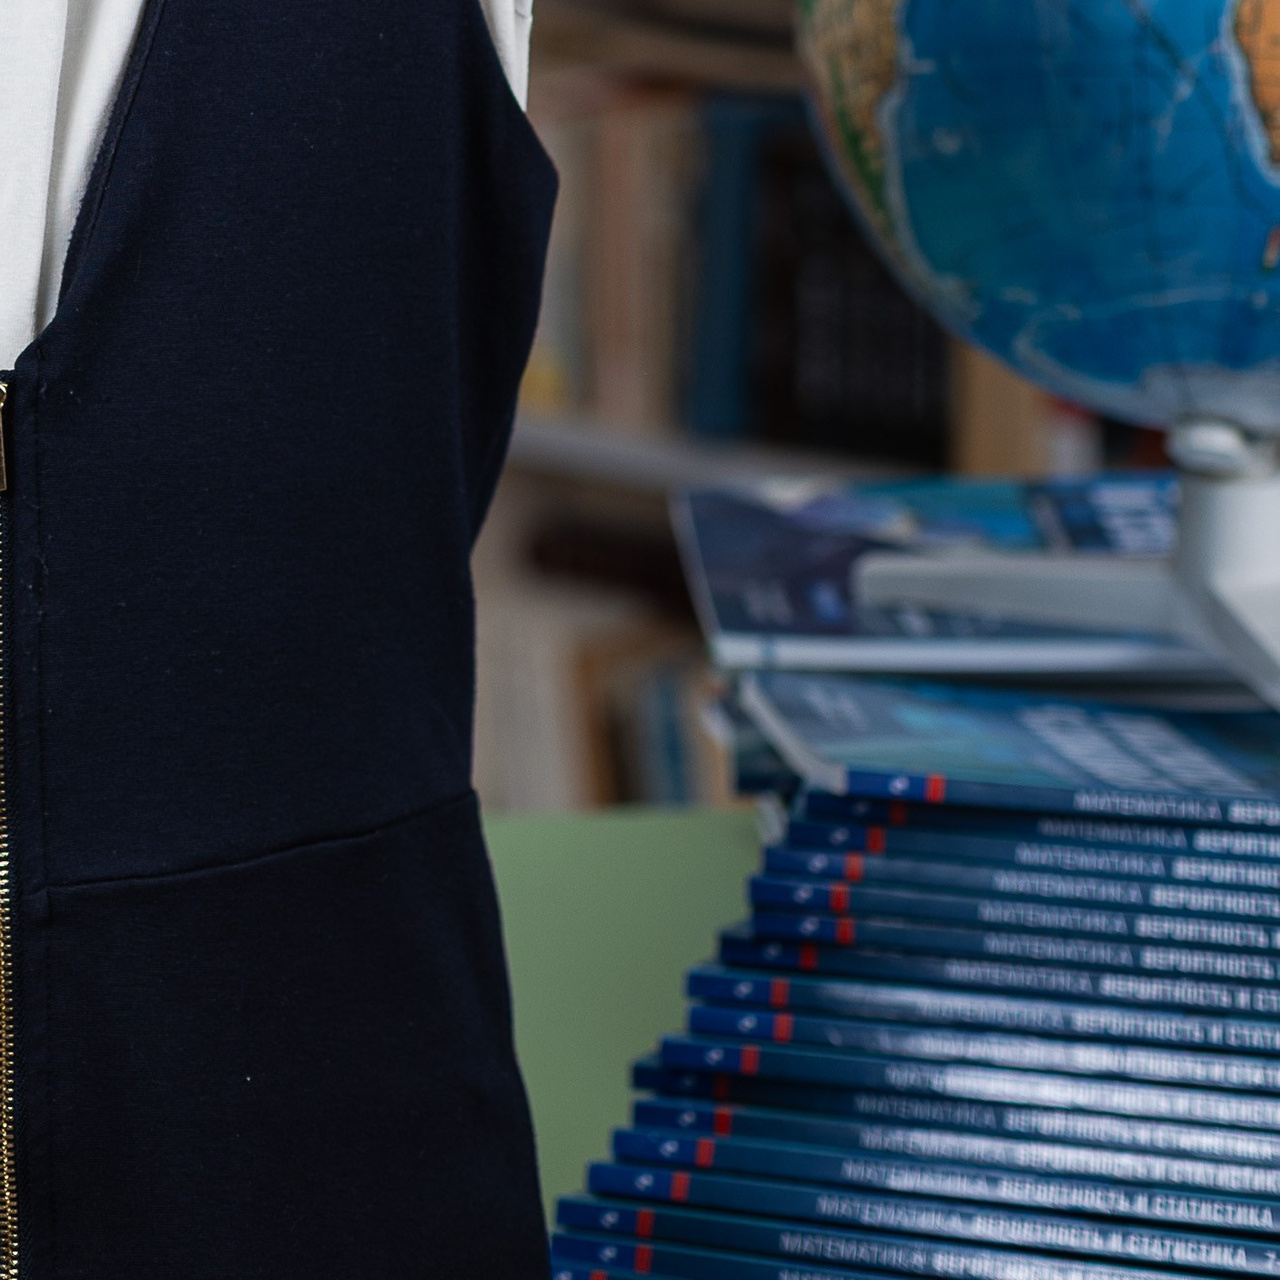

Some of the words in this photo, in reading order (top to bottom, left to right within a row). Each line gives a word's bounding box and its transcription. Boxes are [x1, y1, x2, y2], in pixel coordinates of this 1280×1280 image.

[1073, 788, 1222, 820] МАТЕМАТИКА
[1014, 842, 1166, 877] МАТЕМАТИКА
[992, 870, 1144, 905] МАТЕМАТИКА
[977, 900, 1128, 934] МАТЕМАТИКА
[983, 933, 1134, 967] МАТЕМАТИКА
[1153, 1195, 1274, 1229] СТАТИСТИКА
[816, 1194, 963, 1233] МАТЕМАТИКА
[1126, 1233, 1247, 1269] СТАТИСТИКА
[779, 1231, 927, 1271] МАТЕМАТИКА
